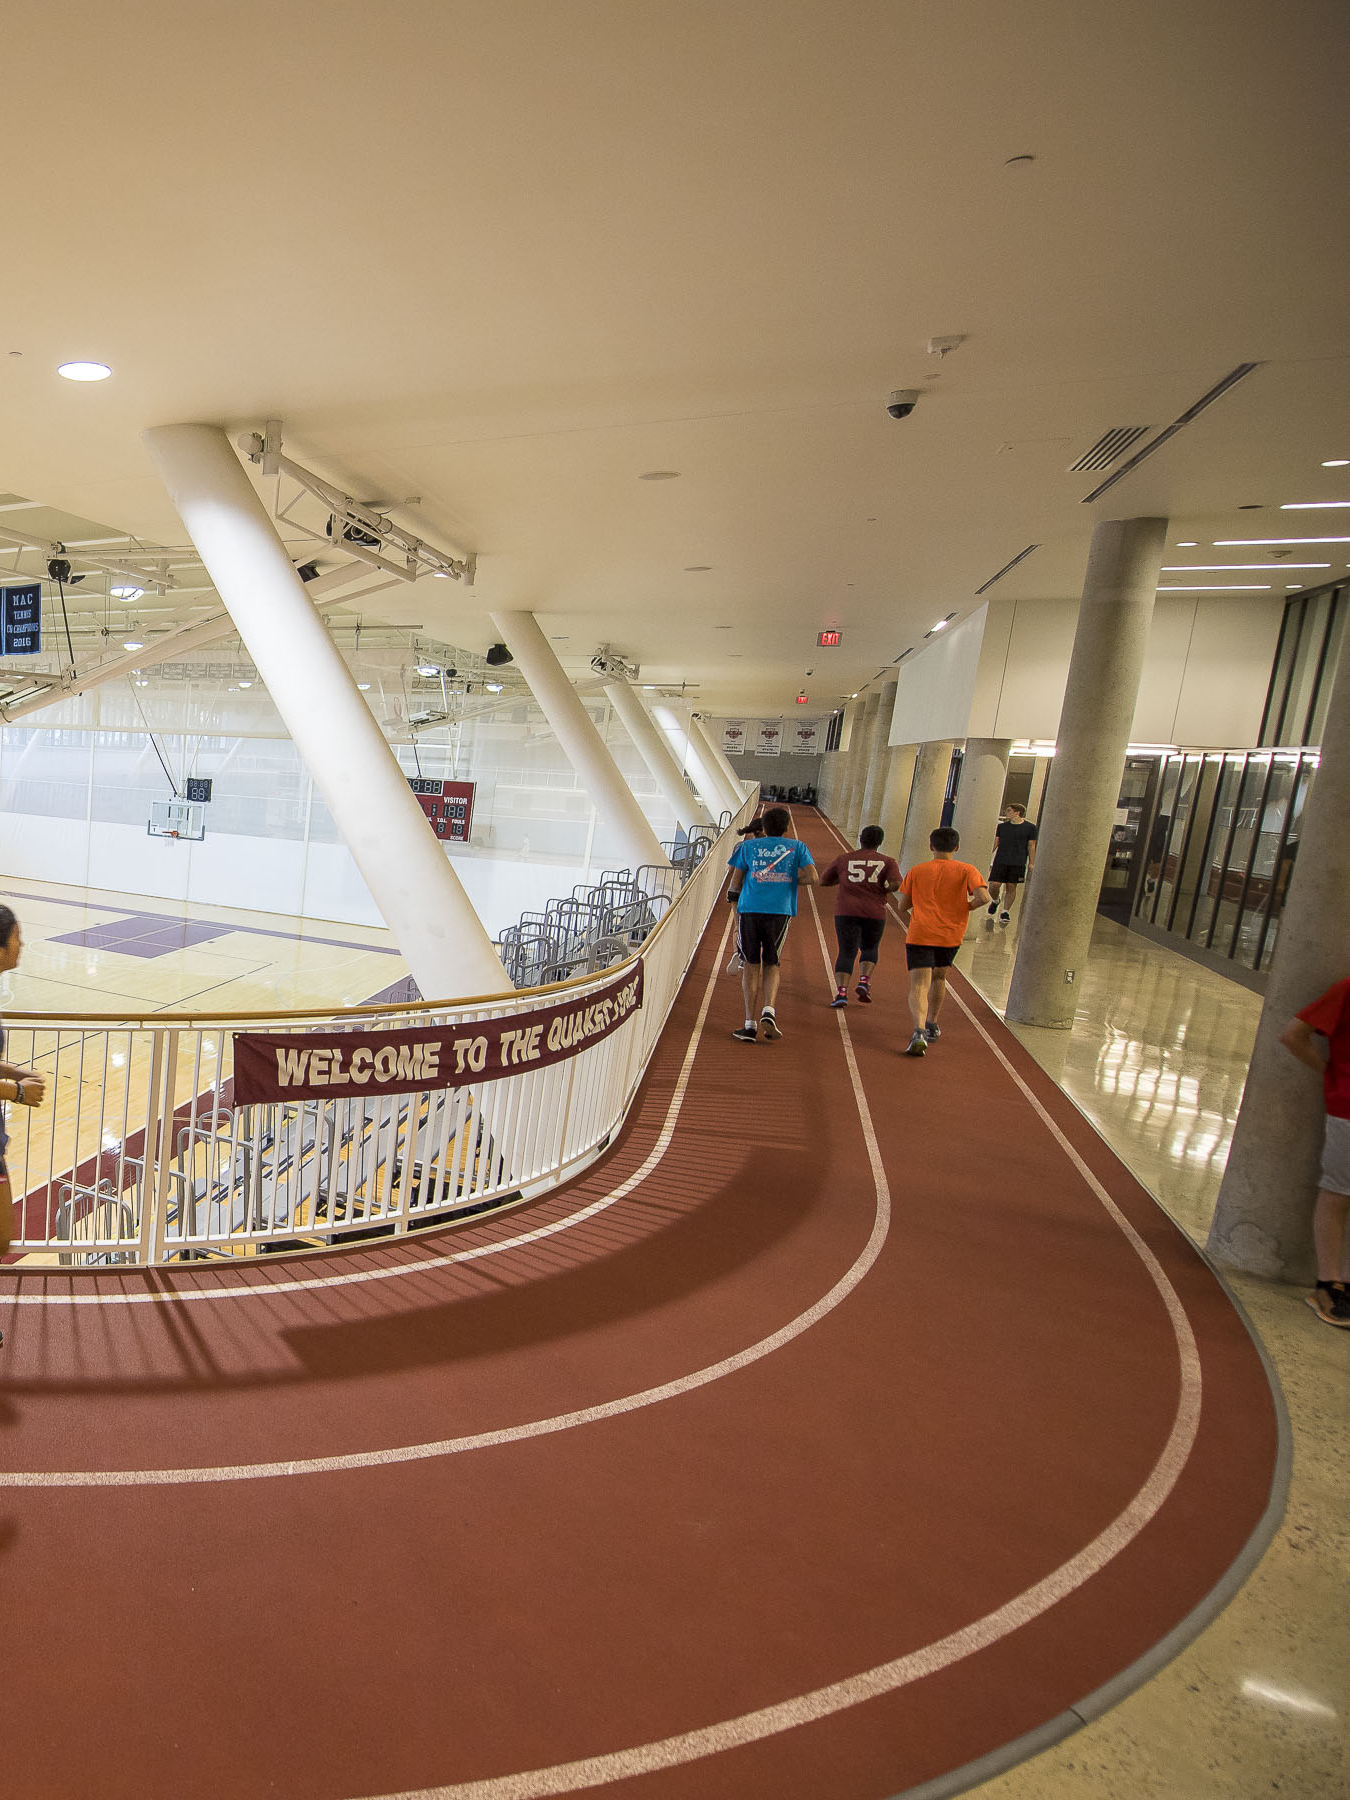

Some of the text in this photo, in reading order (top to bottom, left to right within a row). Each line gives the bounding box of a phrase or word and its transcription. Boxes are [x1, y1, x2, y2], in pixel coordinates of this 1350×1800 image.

[12, 593, 33, 606] MAC
[13, 609, 32, 620] TENNIS
[13, 637, 31, 647] 2016
[821, 632, 840, 646] EXIT
[444, 797, 468, 805] VISITOR
[847, 860, 886, 883] 57
[276, 1042, 441, 1087] WELCOME
[452, 1036, 487, 1074] TO
[499, 1023, 542, 1067] THE
